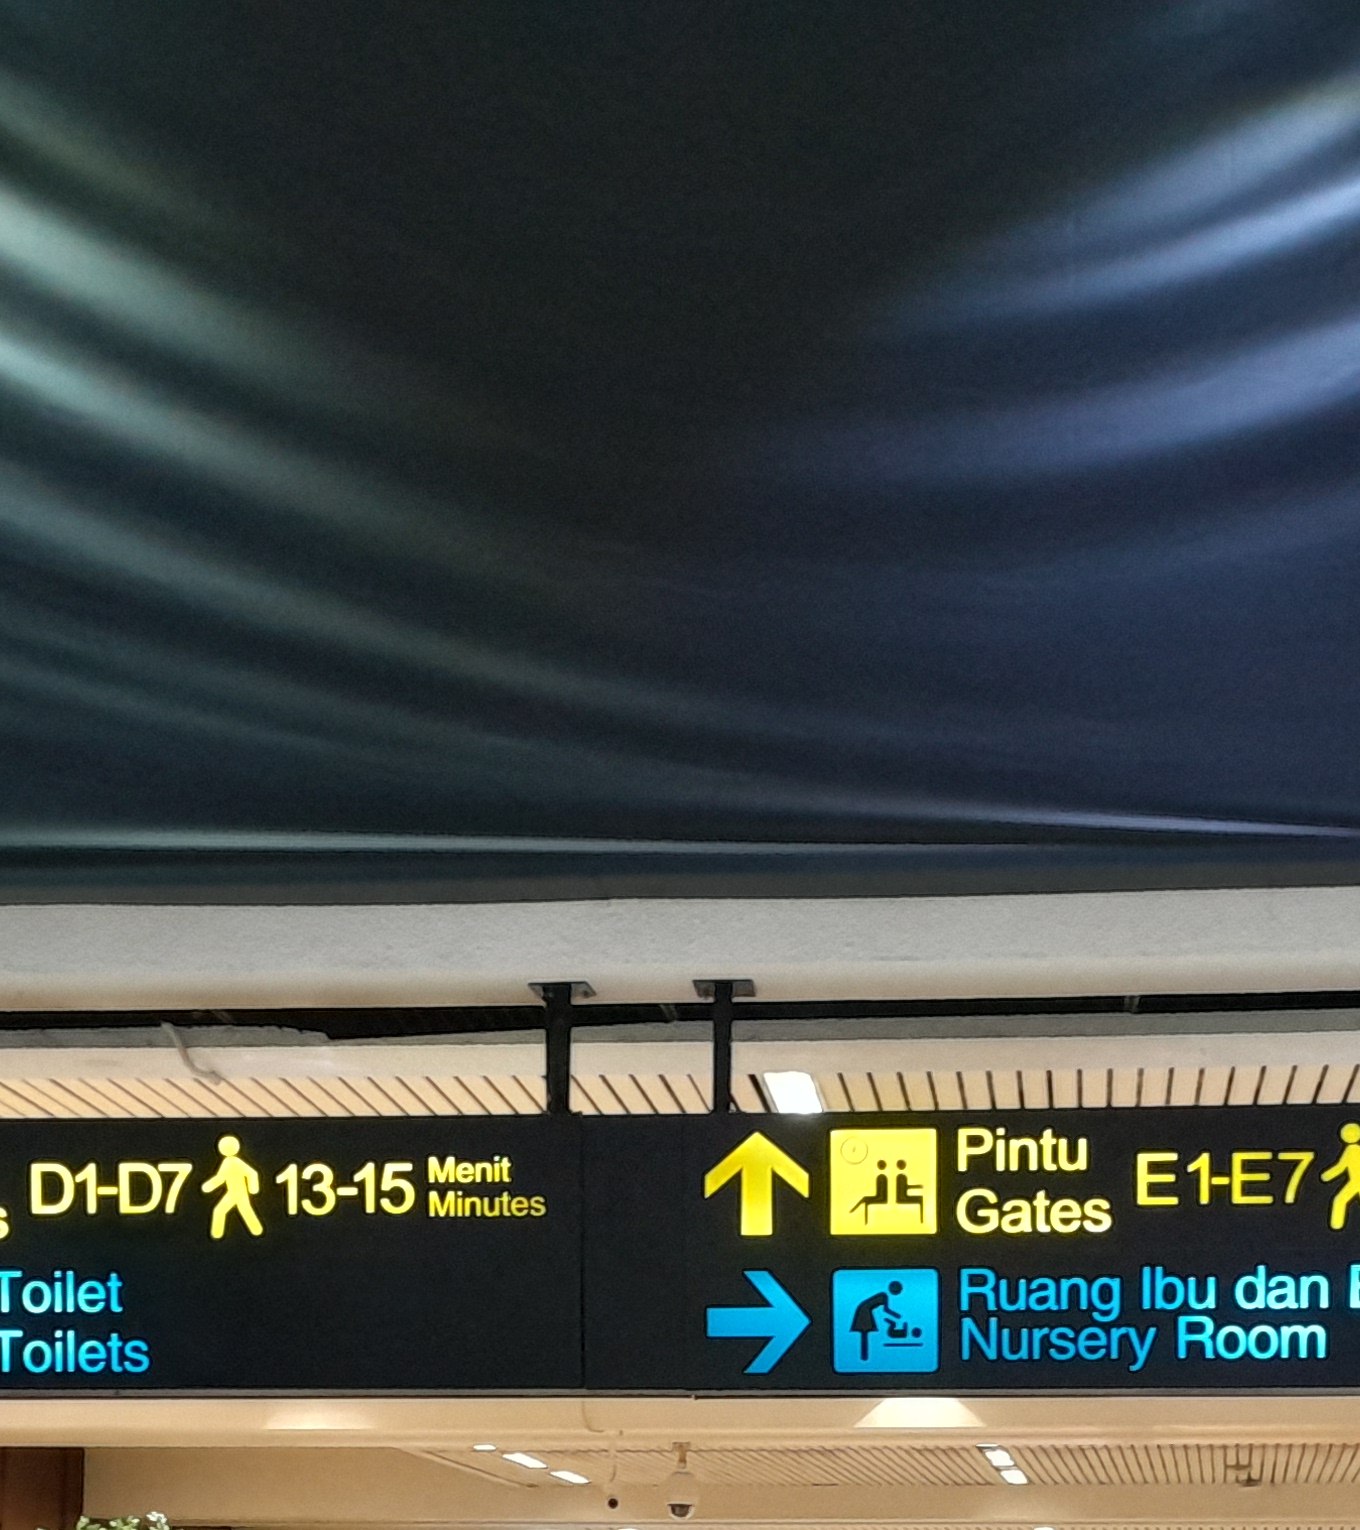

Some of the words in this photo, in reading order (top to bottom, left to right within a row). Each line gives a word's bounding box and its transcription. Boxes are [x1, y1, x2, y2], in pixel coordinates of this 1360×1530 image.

[427, 1155, 512, 1184] Menit
[957, 1126, 1088, 1173] Pintu
[30, 1161, 193, 1215] D1-D7
[276, 1161, 416, 1216] 13-15
[428, 1190, 547, 1218] Minutes
[1136, 1151, 1315, 1206] E1-E7
[955, 1187, 1113, 1235] Gates
[959, 1268, 1121, 1323] Ruang
[1141, 1266, 1217, 1311] Ibu
[1233, 1264, 1330, 1311] dan
[961, 1316, 1157, 1372] Nursery
[1177, 1314, 1327, 1360] Room
